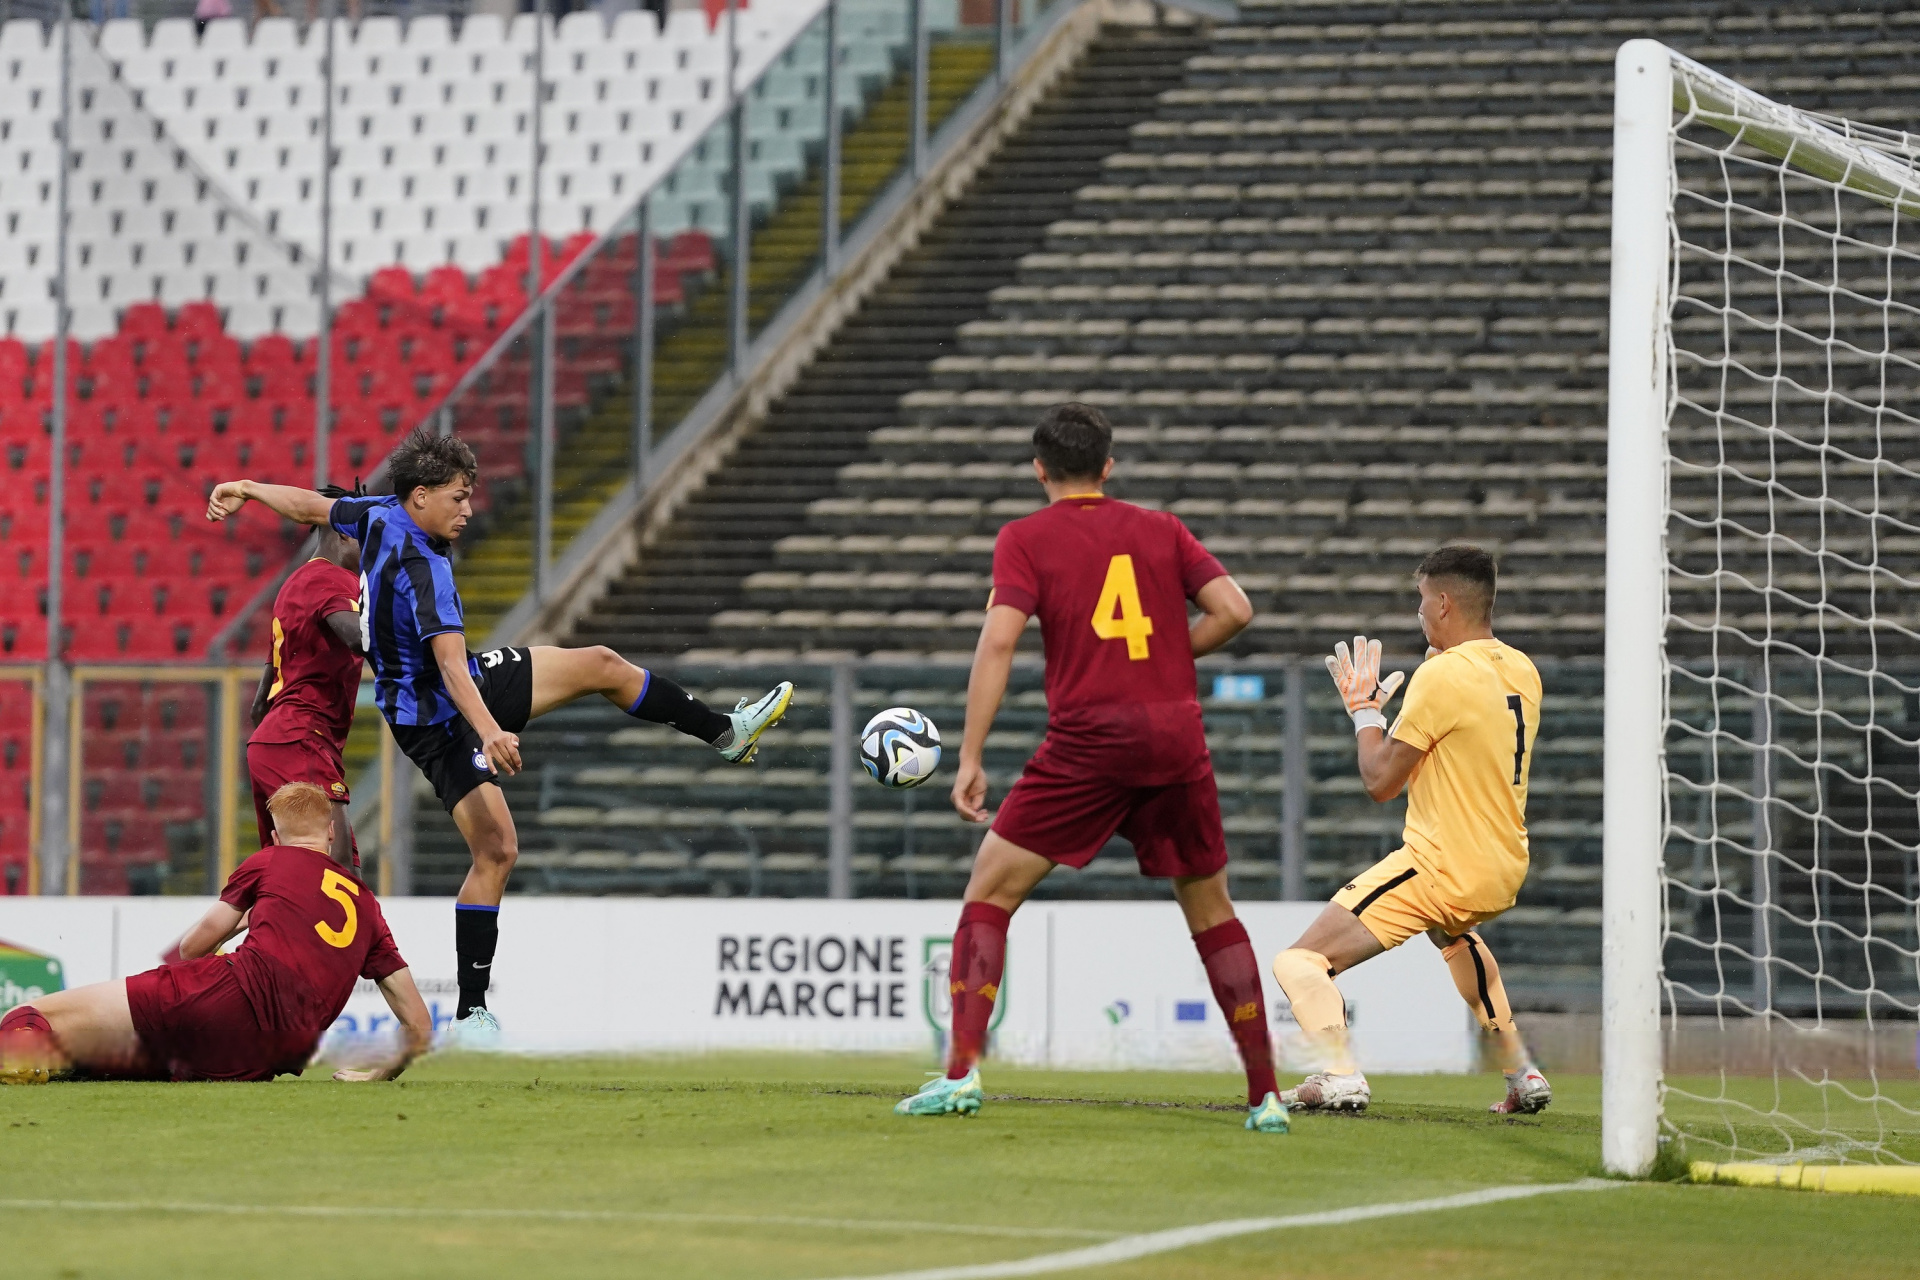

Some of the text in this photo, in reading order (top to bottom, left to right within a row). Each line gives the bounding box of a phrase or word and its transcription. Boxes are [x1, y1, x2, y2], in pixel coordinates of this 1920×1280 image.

[1091, 554, 1153, 661] 4
[1506, 694, 1526, 785] 1
[314, 868, 360, 949] 5
[717, 936, 905, 972] REGIONE
[714, 981, 905, 1017] MARCHE
